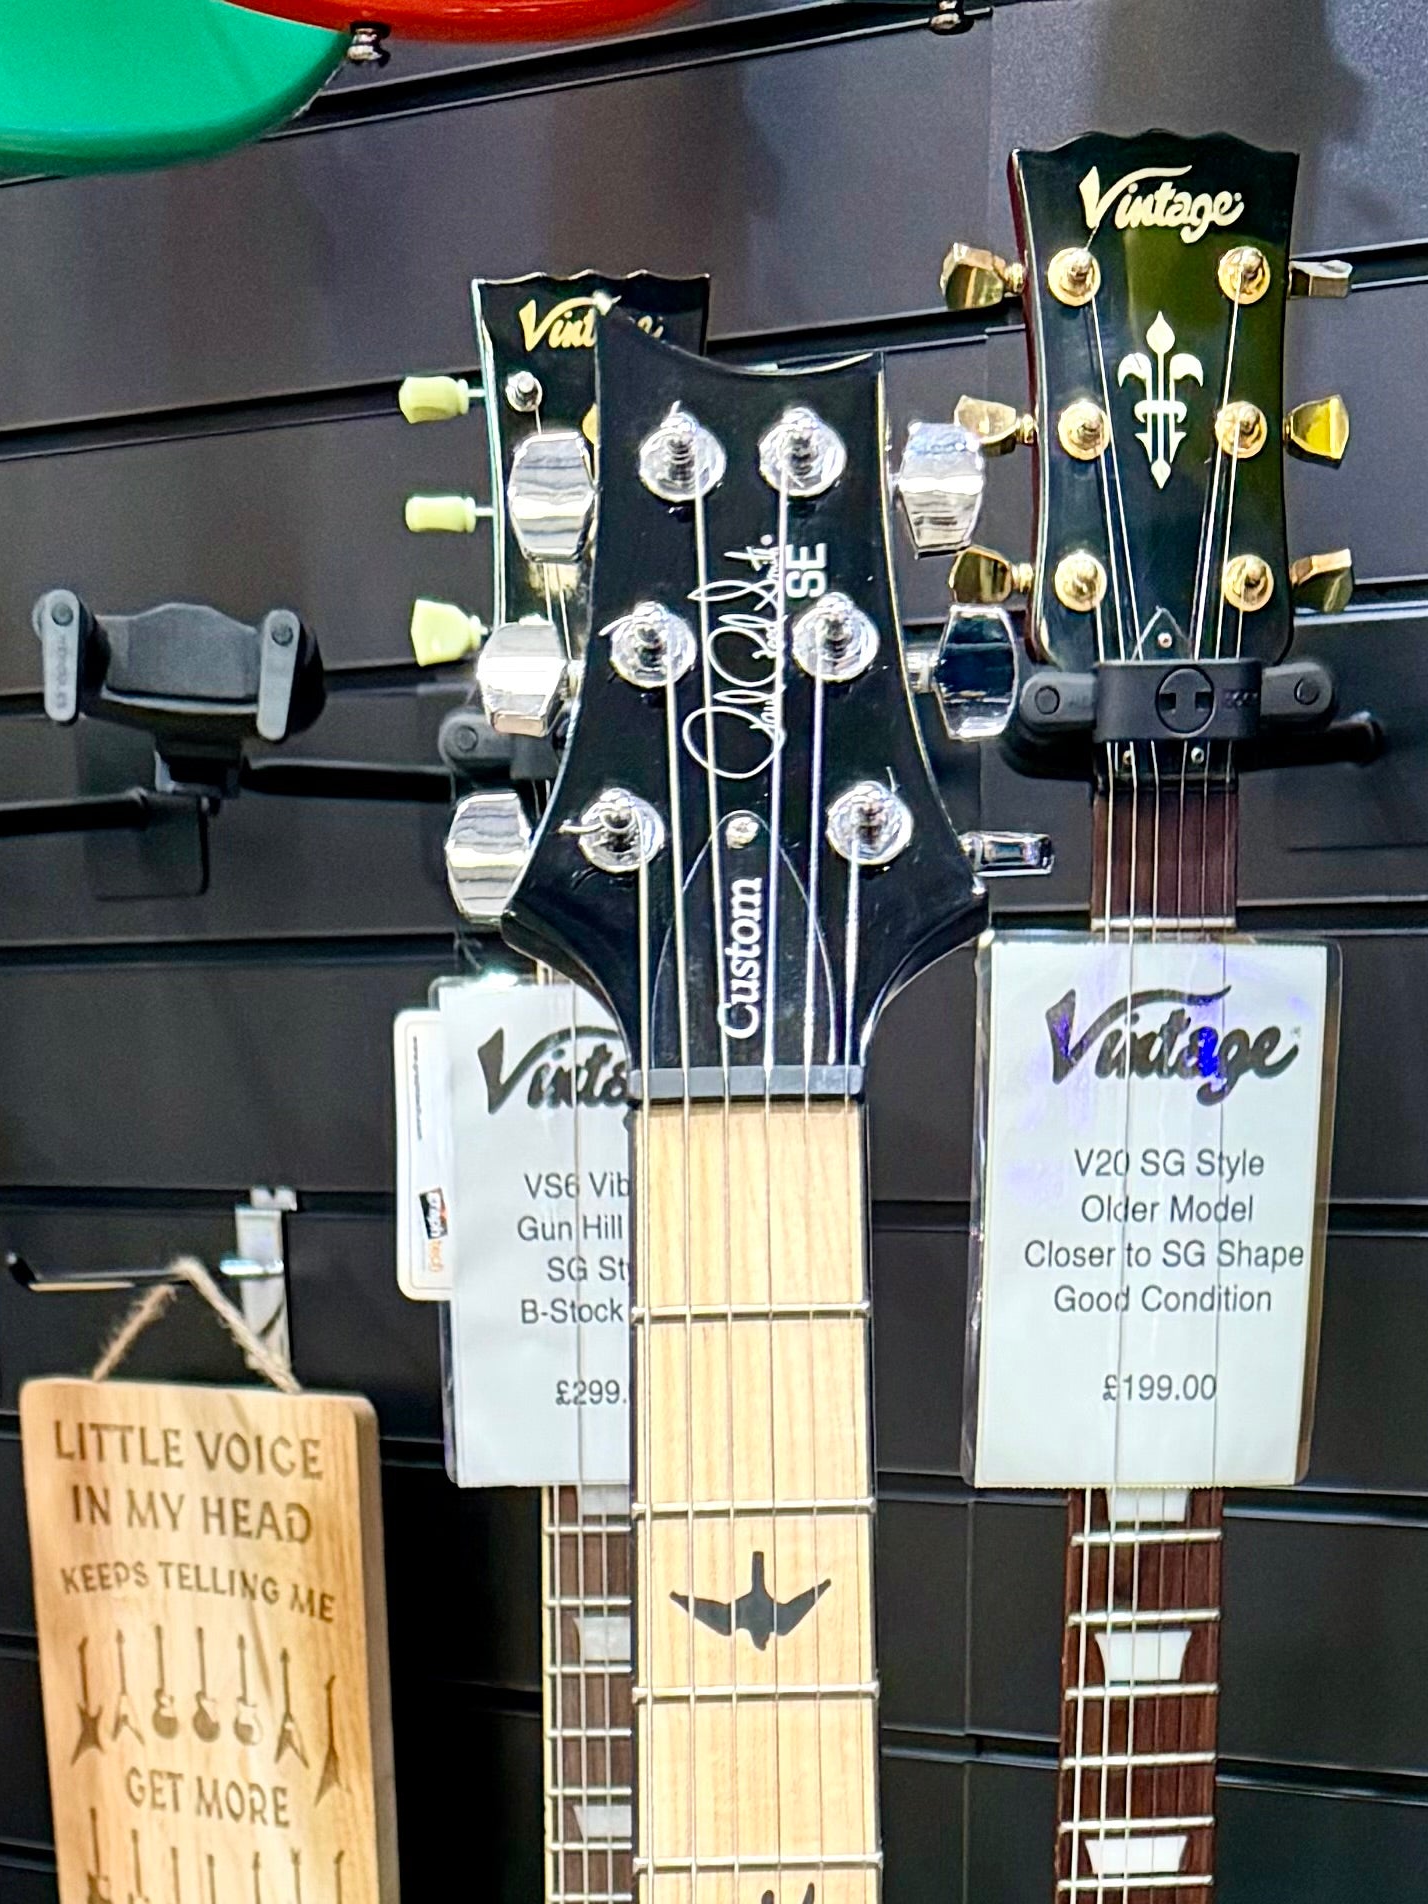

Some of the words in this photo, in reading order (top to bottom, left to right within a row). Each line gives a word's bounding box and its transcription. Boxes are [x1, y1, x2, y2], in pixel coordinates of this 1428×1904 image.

[1079, 165, 1244, 244] Vintage
[785, 543, 827, 598] SE
[718, 877, 762, 1039] Custom
[1045, 984, 1299, 1106] Vintage
[1074, 1149, 1130, 1178] V20
[1140, 1148, 1185, 1177] SG
[1196, 1149, 1265, 1183] Style
[524, 1172, 580, 1200] VS6
[1081, 1195, 1159, 1223] Older
[1170, 1194, 1254, 1223] Model
[517, 1216, 573, 1242] Gun
[582, 1215, 623, 1241] Hill
[547, 1256, 587, 1283] SG
[1024, 1240, 1116, 1269] Closer
[1125, 1242, 1152, 1268] to
[1161, 1240, 1206, 1268] SG
[1217, 1240, 1304, 1273] Shape
[521, 1299, 623, 1325] B-Stock
[1054, 1286, 1129, 1313] Good
[1142, 1285, 1272, 1313] Condition
[1103, 1374, 1217, 1402] £199.00
[54, 1420, 184, 1471] LITTLE
[195, 1430, 324, 1481] VOICE
[72, 1485, 111, 1528] IN
[125, 1488, 185, 1536] MY
[201, 1496, 313, 1545] HEAD
[61, 1561, 150, 1595] KEEPS
[157, 1561, 281, 1608] TELLING
[291, 1583, 337, 1624] ME
[125, 1766, 184, 1813] GET
[194, 1776, 292, 1830] MORE
